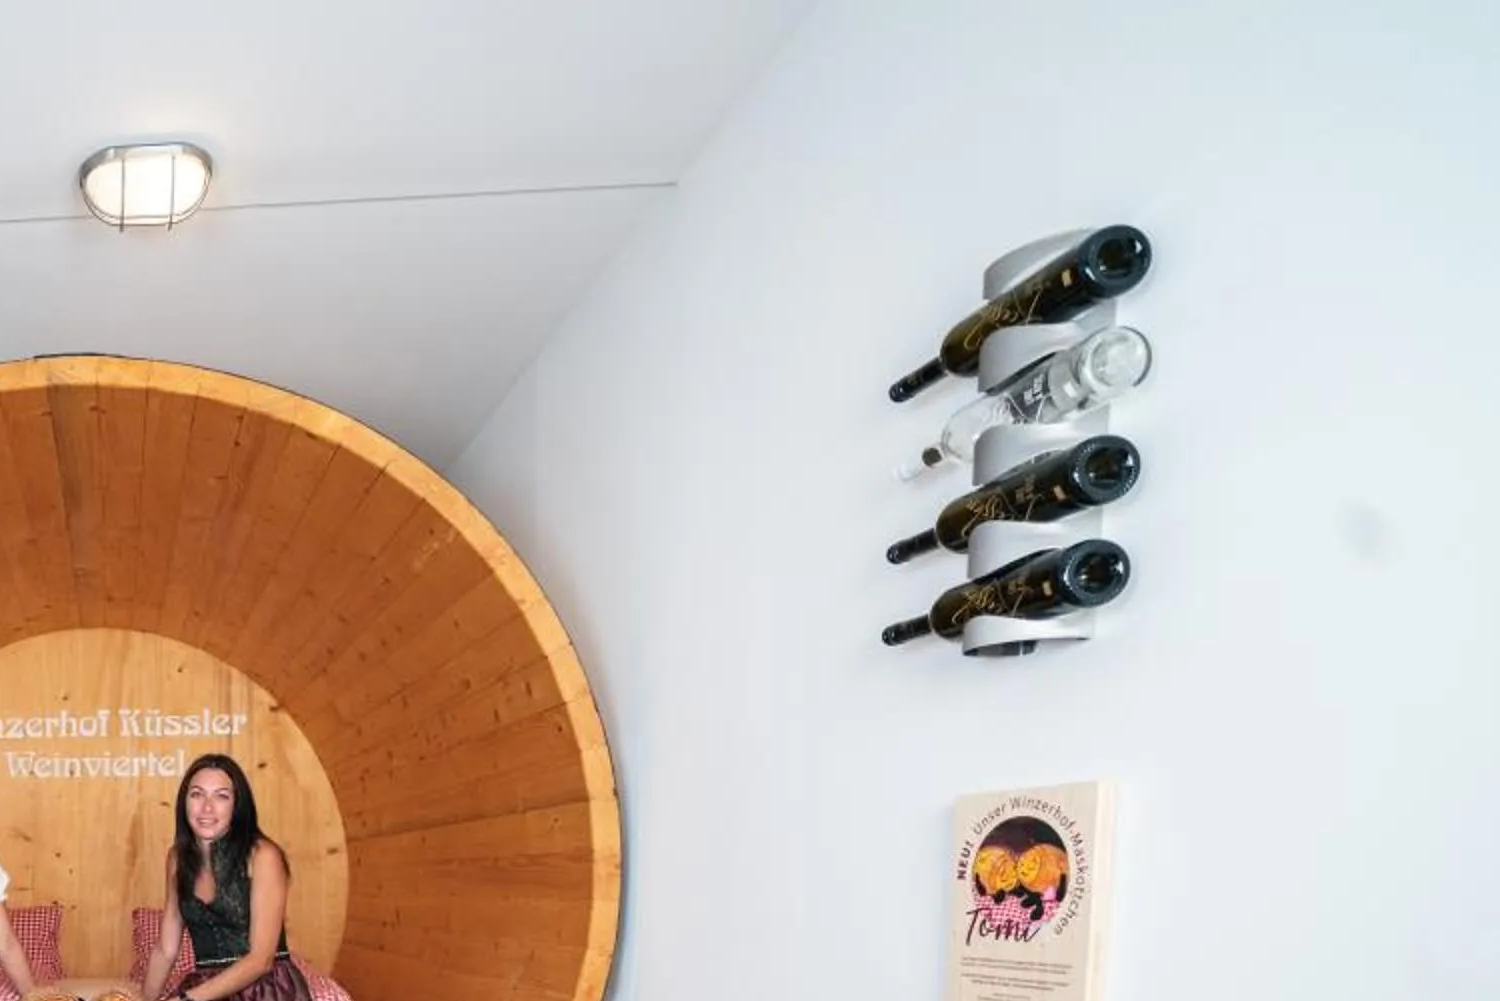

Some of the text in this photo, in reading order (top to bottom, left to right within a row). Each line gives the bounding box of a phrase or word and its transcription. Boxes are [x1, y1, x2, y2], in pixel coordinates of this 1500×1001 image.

[118, 707, 247, 737] Küssler
[5, 750, 185, 778] Weinviertel
[973, 804, 1007, 835] Unser
